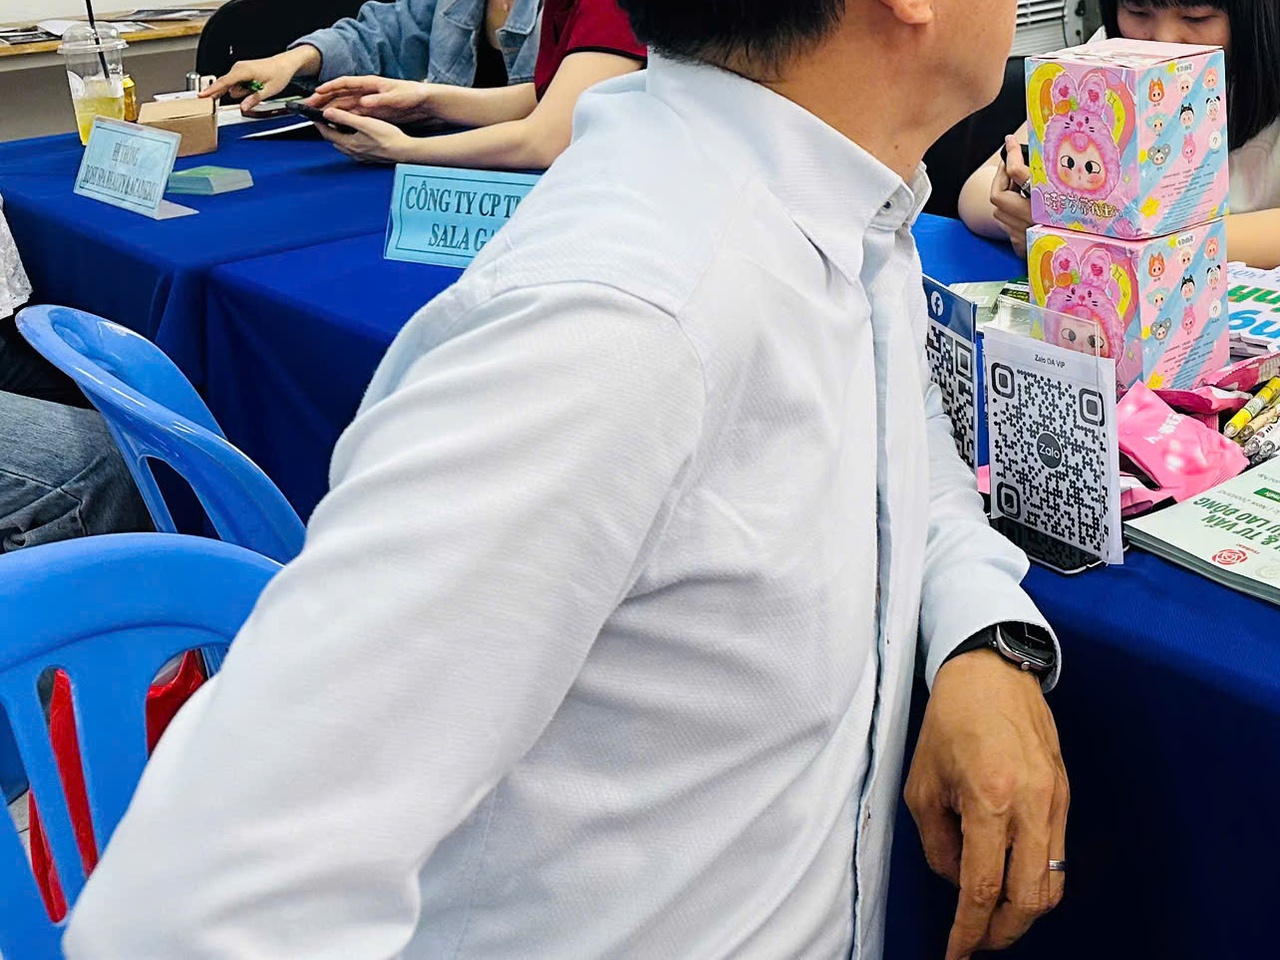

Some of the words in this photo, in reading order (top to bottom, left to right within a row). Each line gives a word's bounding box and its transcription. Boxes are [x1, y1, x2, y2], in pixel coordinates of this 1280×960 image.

[405, 180, 451, 213] CÔNG
[454, 190, 477, 215] TY
[479, 193, 500, 217] CP
[428, 223, 470, 250] SALA
[1034, 354, 1046, 364] Zalo
[1047, 358, 1055, 366] OA
[1056, 360, 1066, 368] VIP
[1039, 442, 1060, 460] Zalo
[1192, 497, 1240, 517] ĐỘNG
[1235, 512, 1271, 528] LAO
[1260, 534, 1279, 548] &
